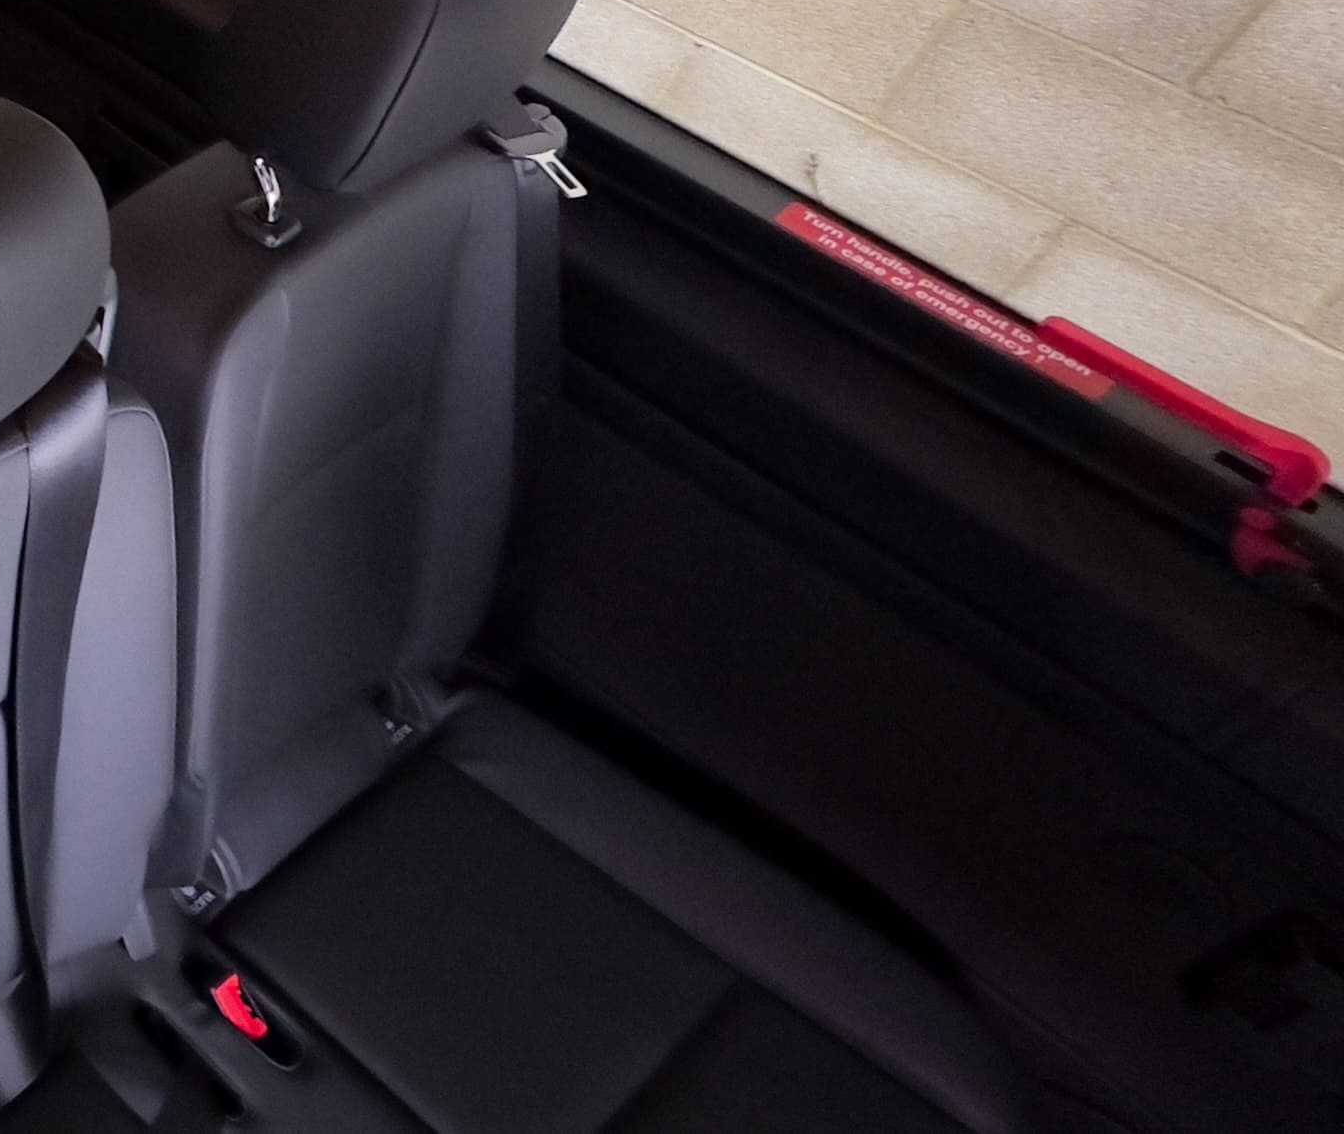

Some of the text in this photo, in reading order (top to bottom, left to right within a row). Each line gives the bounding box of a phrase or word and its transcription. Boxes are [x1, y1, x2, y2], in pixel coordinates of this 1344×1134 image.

[803, 210, 844, 239] Turn
[917, 278, 970, 309] push
[973, 307, 1010, 330] out
[1011, 327, 1035, 343] to
[1037, 343, 1091, 375] open
[841, 248, 887, 277] case
[890, 275, 915, 290] of
